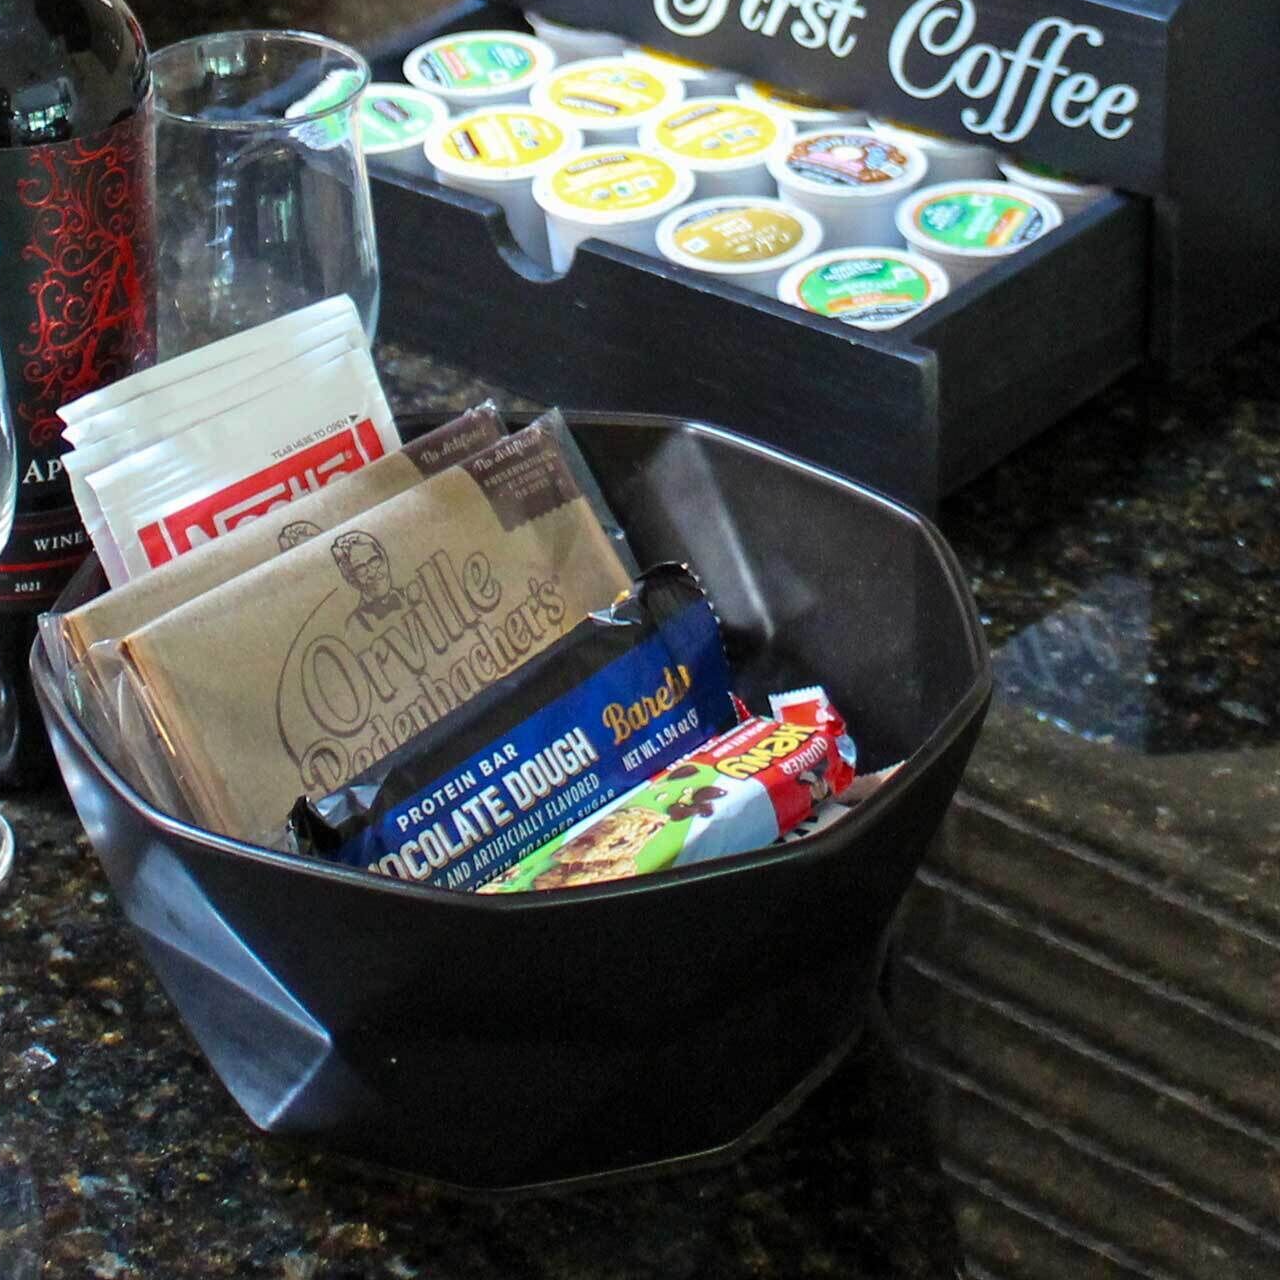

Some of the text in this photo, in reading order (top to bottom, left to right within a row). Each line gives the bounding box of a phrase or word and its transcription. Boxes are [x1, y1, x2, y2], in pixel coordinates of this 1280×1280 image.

[313, 429, 326, 439] TO
[326, 418, 348, 433] OPEN
[34, 533, 84, 552] WINE
[15, 581, 41, 592] 2021
[301, 548, 501, 738] Orville
[622, 748, 643, 772] NET
[639, 739, 660, 759] WT.
[656, 723, 679, 748] 1.94
[677, 718, 690, 734] oz
[782, 736, 829, 776] QUAKER
[368, 785, 514, 881] OCOLATE
[502, 727, 600, 812] DOUGH
[396, 742, 520, 833] PROTEIN BAR
[577, 788, 616, 819] SUGAR
[446, 772, 600, 889] AND ARTIFICIALLY FLAVORED
